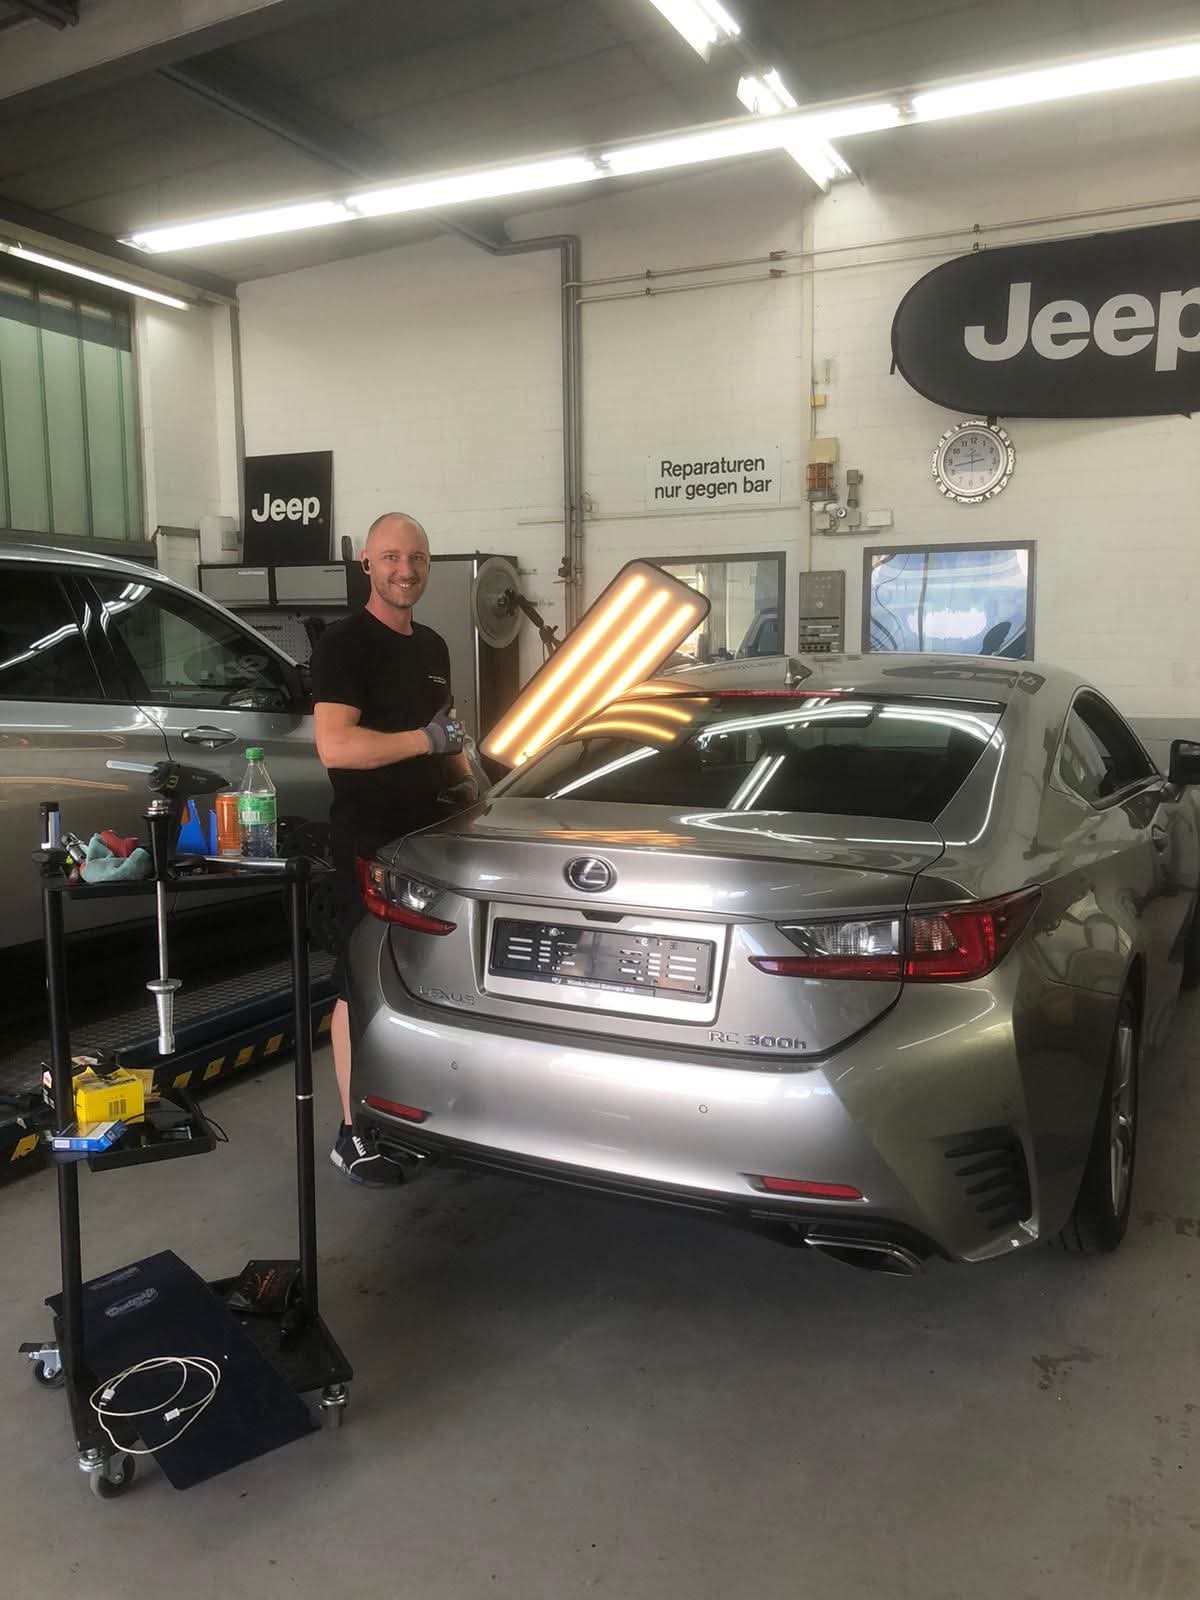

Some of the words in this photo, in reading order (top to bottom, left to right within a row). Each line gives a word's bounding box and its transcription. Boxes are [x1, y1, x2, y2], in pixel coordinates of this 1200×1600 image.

[964, 282, 1200, 372] Jeep
[660, 457, 765, 480] Reparaturen
[655, 485, 681, 499] nur
[685, 481, 737, 500] gegen
[743, 476, 772, 493] bar
[251, 493, 320, 525] Jeep
[708, 1030, 739, 1044] RC
[743, 1033, 807, 1049] 300h
